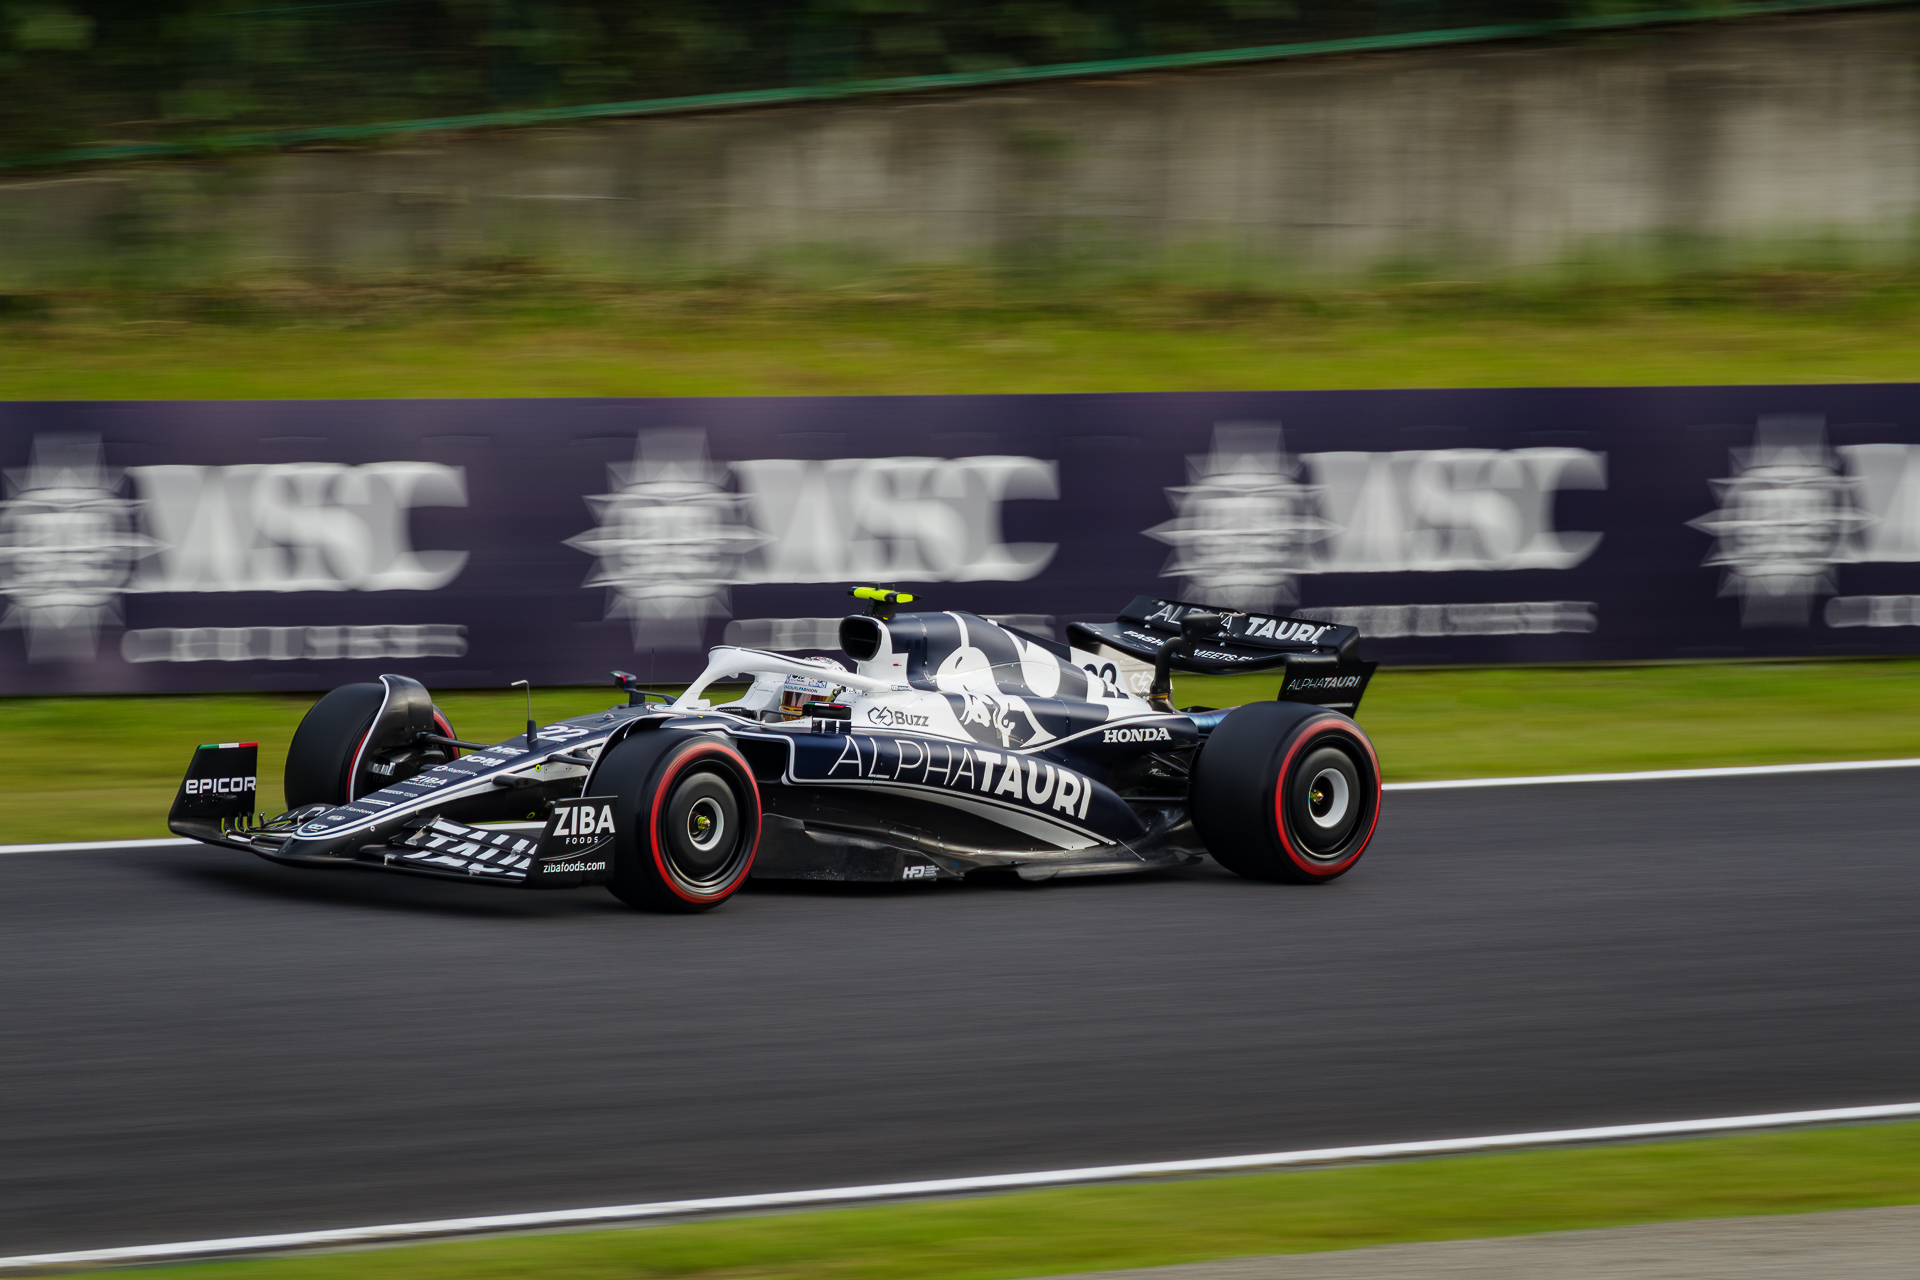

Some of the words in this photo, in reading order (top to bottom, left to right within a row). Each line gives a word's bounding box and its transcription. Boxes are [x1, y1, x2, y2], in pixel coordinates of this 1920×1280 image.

[1245, 617, 1325, 642] TAURI
[1287, 675, 1361, 690] ALPHATAURI
[522, 725, 589, 742] 22
[1103, 727, 1172, 743] HONDA
[828, 735, 1092, 820] ALPHATAURI
[553, 805, 615, 836] ZIBA
[565, 836, 599, 845] FOODS
[543, 861, 606, 873] zibafoods.com
